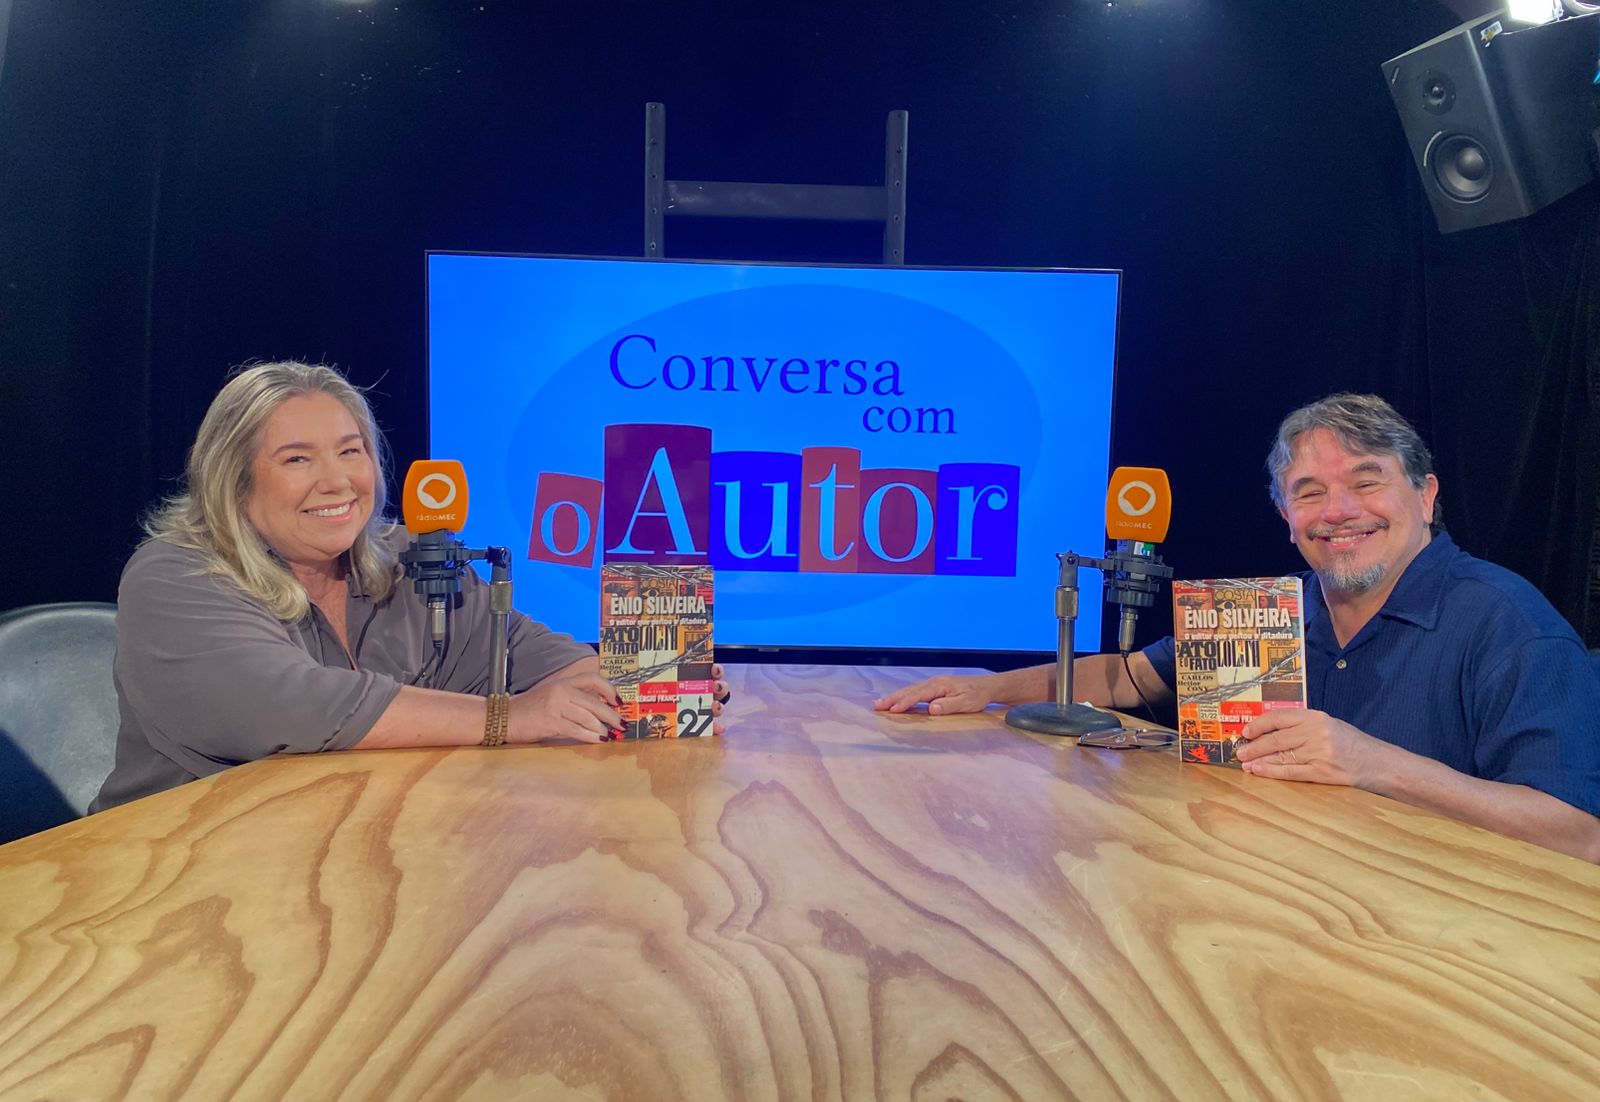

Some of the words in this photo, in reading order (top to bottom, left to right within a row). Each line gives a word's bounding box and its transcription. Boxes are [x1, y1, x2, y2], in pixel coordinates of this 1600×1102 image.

[609, 334, 905, 396] Conversa
[861, 405, 958, 434] com
[540, 500, 592, 557] o
[605, 446, 1009, 563] Autor
[611, 593, 643, 615] ÊNIO
[646, 595, 706, 615] SILVEIRA
[1184, 606, 1218, 629] ÊNIO
[1222, 607, 1292, 628] SILVEIRA
[602, 627, 640, 643] ATO
[1260, 632, 1293, 640] ditadura
[612, 642, 639, 655] FATO
[1178, 641, 1217, 658] ATO
[1189, 658, 1217, 671] FATO
[677, 708, 714, 737] 27
